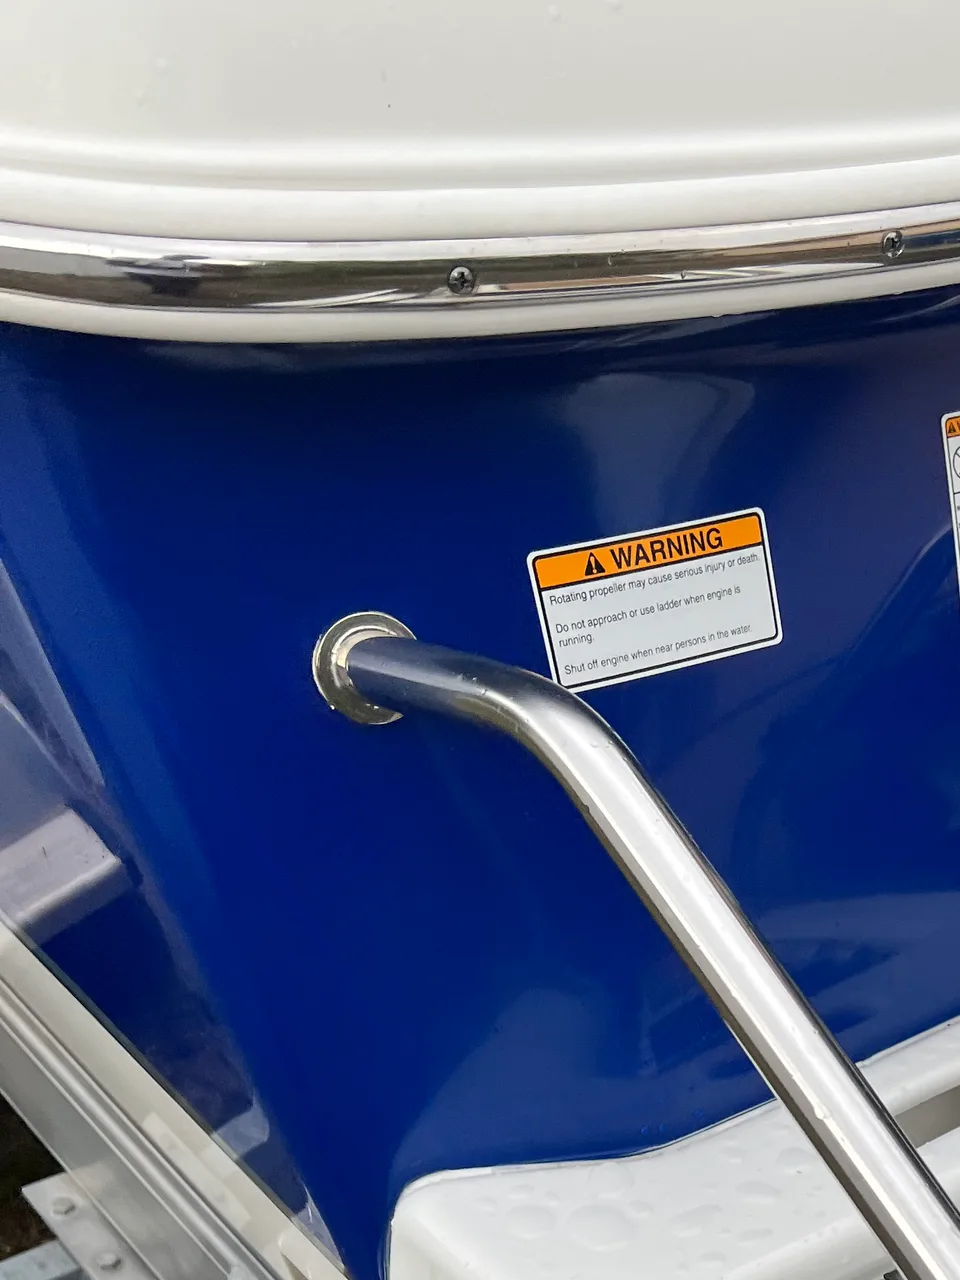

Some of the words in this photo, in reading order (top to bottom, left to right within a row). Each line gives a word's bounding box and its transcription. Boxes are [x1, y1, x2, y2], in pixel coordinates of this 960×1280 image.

[609, 529, 723, 569] WARNING
[549, 591, 587, 605] Rotating
[589, 583, 626, 600] propeller
[628, 579, 645, 589] may
[648, 573, 672, 585] cause
[674, 566, 703, 580] serious
[704, 562, 725, 574] injury
[727, 559, 735, 568] or
[737, 553, 760, 565] death.
[555, 623, 569, 633] Do
[571, 619, 586, 630] not
[588, 610, 627, 628] approach
[629, 609, 637, 618] or
[640, 606, 655, 615] use
[656, 599, 682, 611] ladder
[683, 594, 705, 605] when
[707, 588, 732, 600] engine
[734, 586, 741, 594] is
[559, 634, 594, 647] running.
[564, 663, 585, 675] Shut
[587, 659, 598, 670] off
[601, 654, 629, 667] engine
[631, 649, 653, 660] when
[655, 644, 673, 654] near
[675, 636, 706, 651] persons
[716, 630, 729, 639] the
[730, 625, 752, 635] water.
